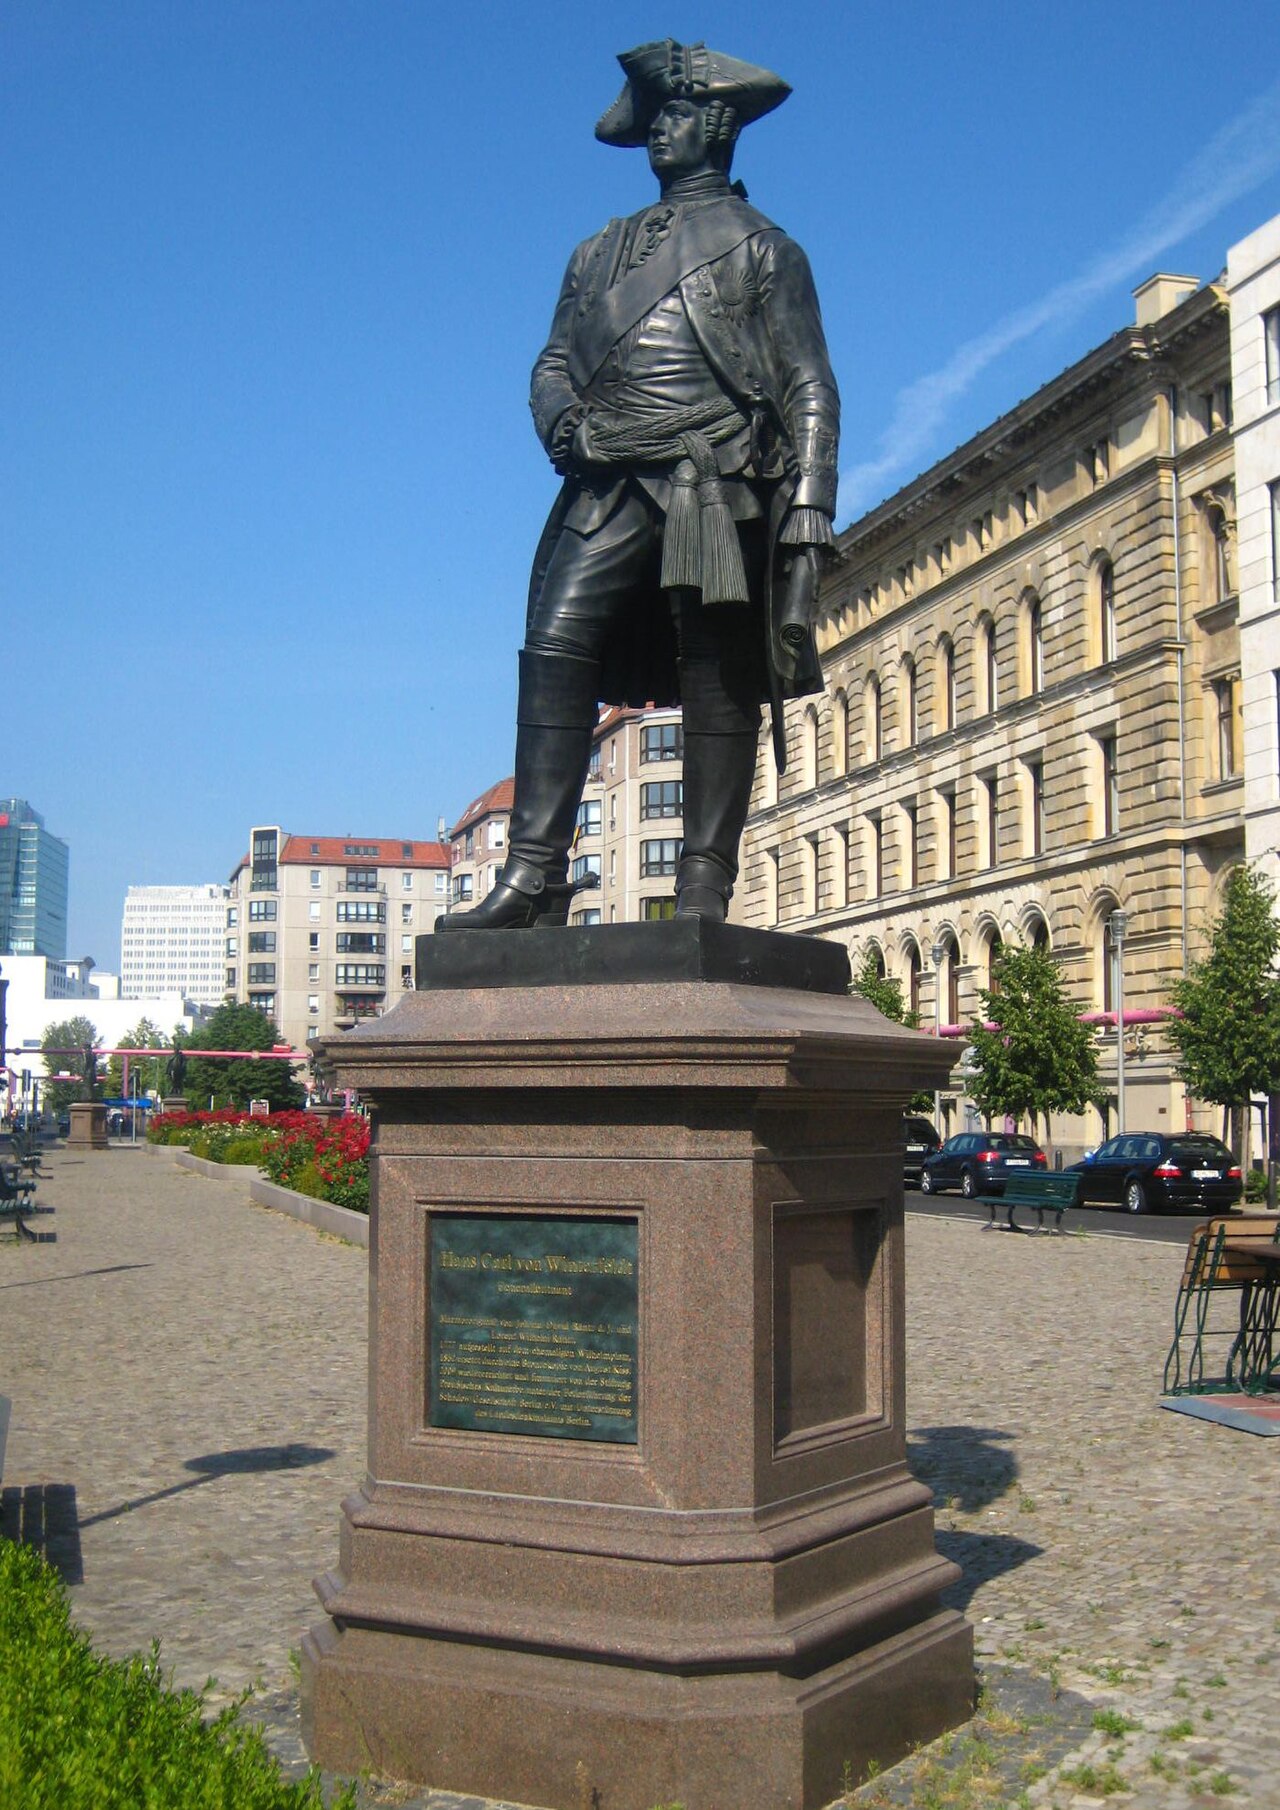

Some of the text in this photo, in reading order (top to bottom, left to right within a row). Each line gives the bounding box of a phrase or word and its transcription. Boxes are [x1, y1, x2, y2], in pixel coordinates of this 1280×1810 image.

[440, 1251, 476, 1267] Hans
[480, 1253, 512, 1269] Carl
[516, 1259, 541, 1270] von
